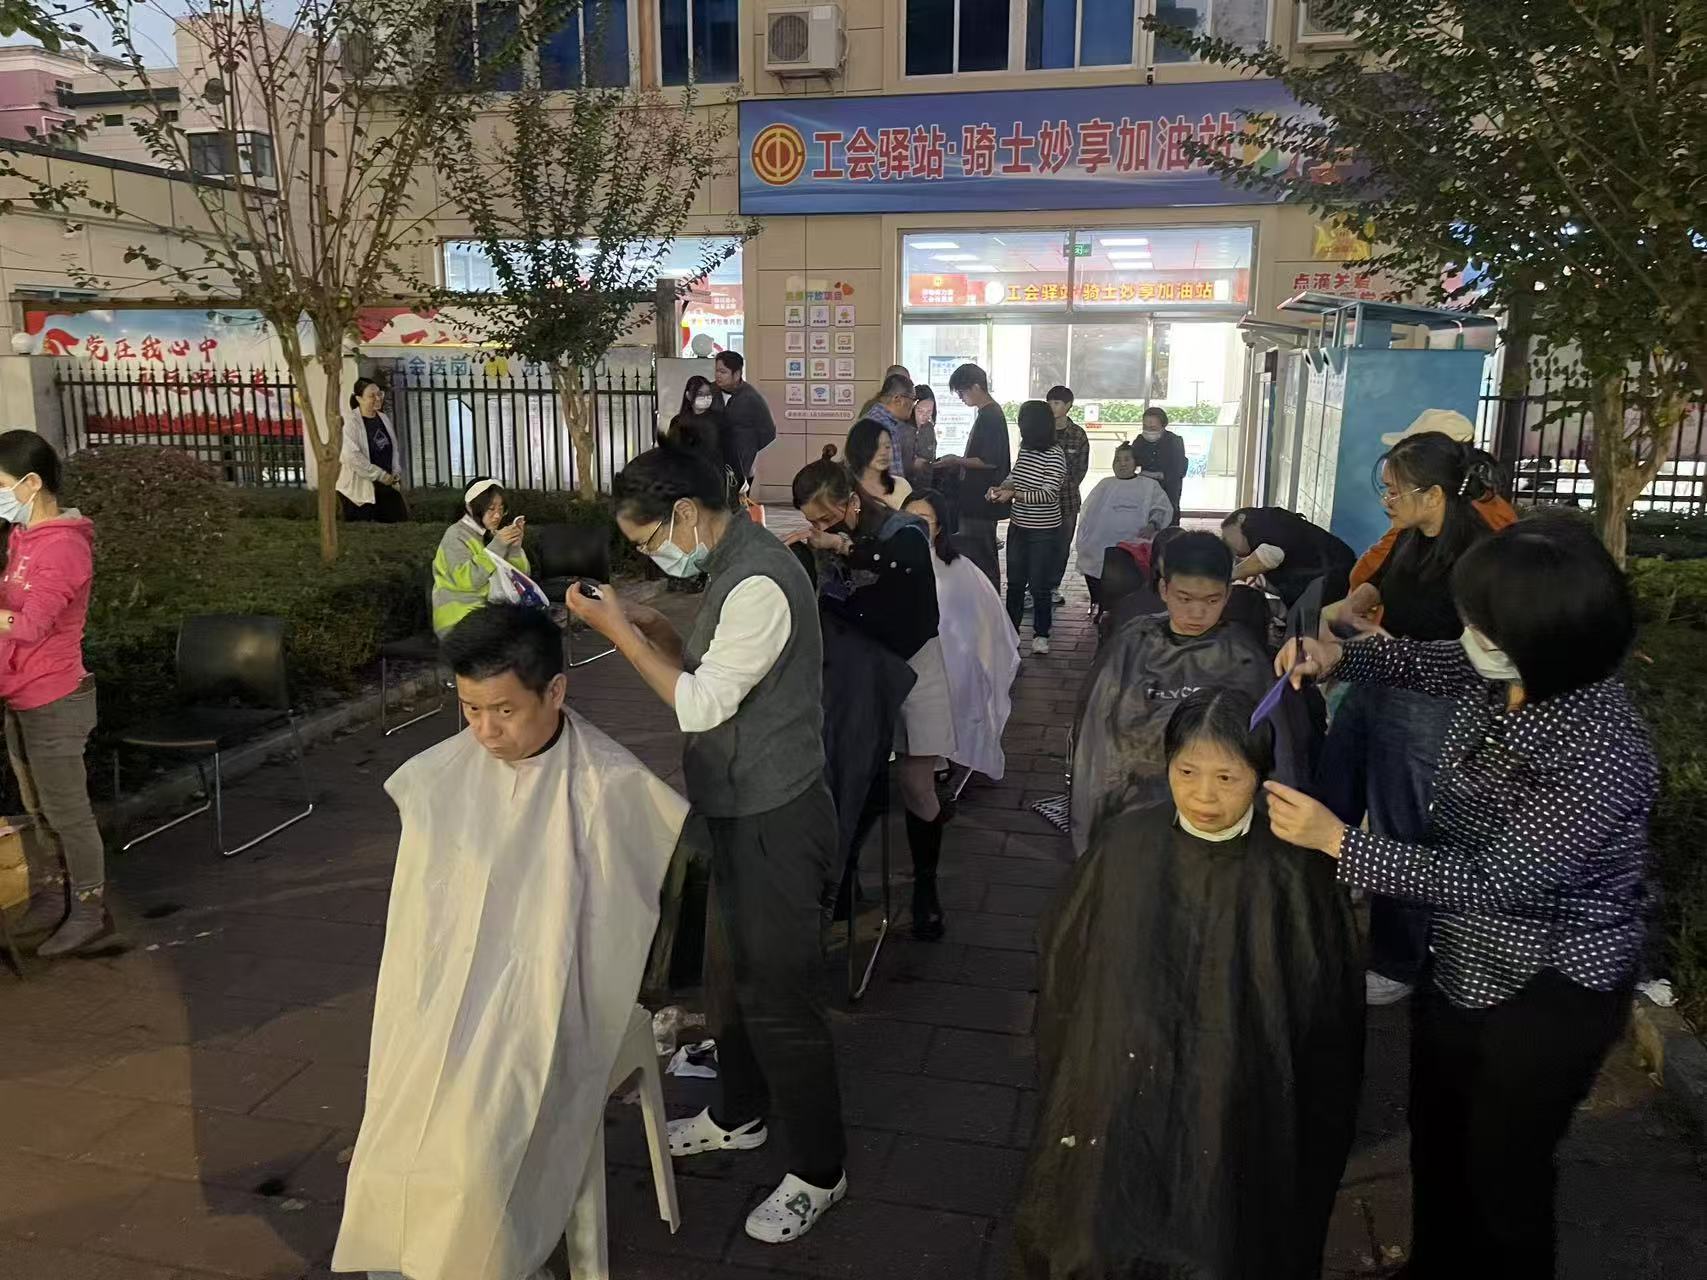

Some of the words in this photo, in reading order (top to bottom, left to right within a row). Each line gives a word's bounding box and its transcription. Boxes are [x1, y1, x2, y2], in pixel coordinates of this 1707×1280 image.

[812, 112, 1237, 180] 工会驿站·骑士妙享加油站
[85, 334, 218, 362] 党在我心中
